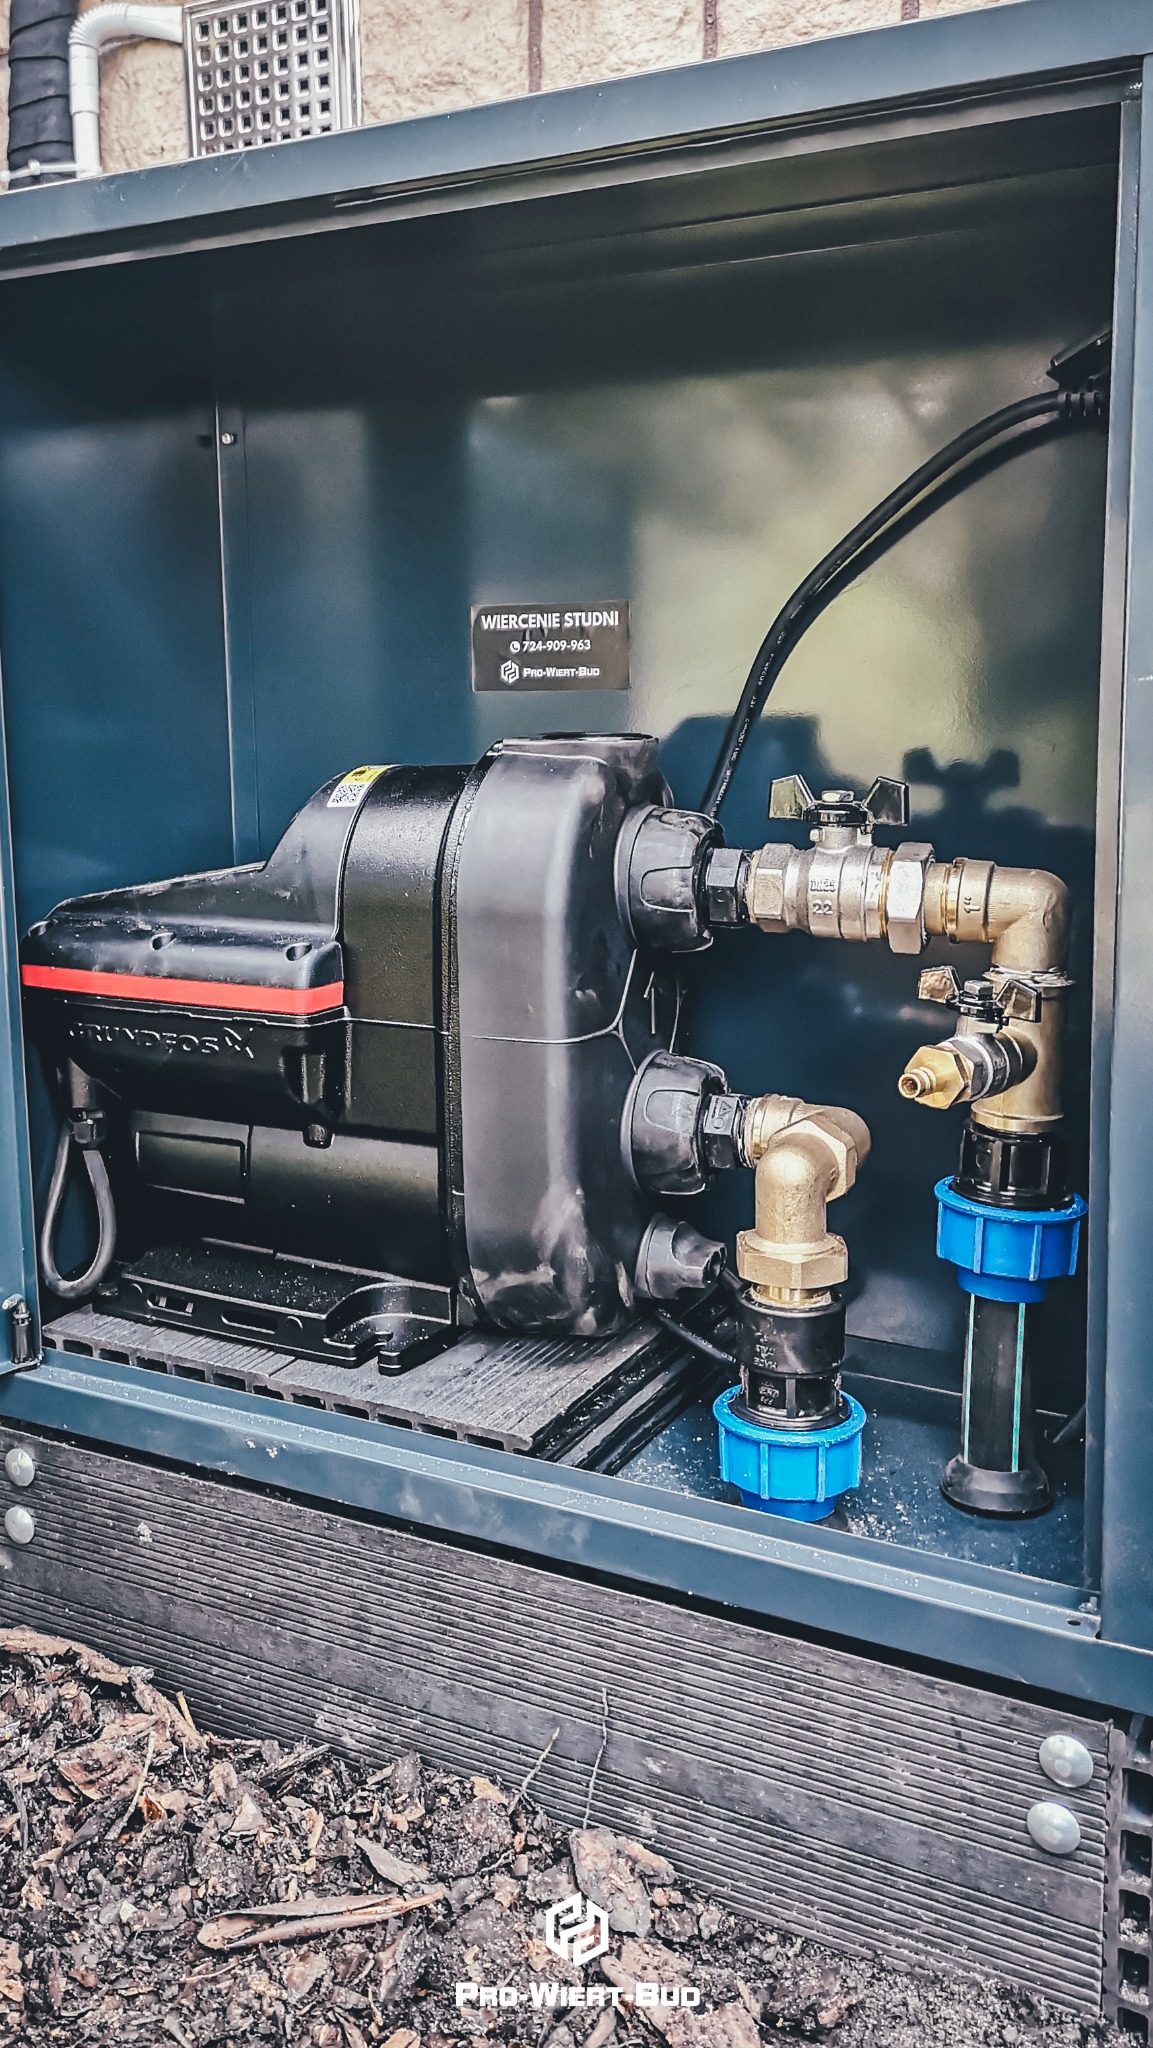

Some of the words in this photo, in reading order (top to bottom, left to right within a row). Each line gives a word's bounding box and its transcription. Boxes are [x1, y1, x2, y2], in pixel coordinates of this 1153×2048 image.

[481, 613, 561, 629] WIERCENIE
[564, 611, 619, 627] STUDNI
[522, 639, 591, 652] 724-909-963
[812, 899, 834, 917] 22
[69, 1022, 220, 1054] GRUNDFOS
